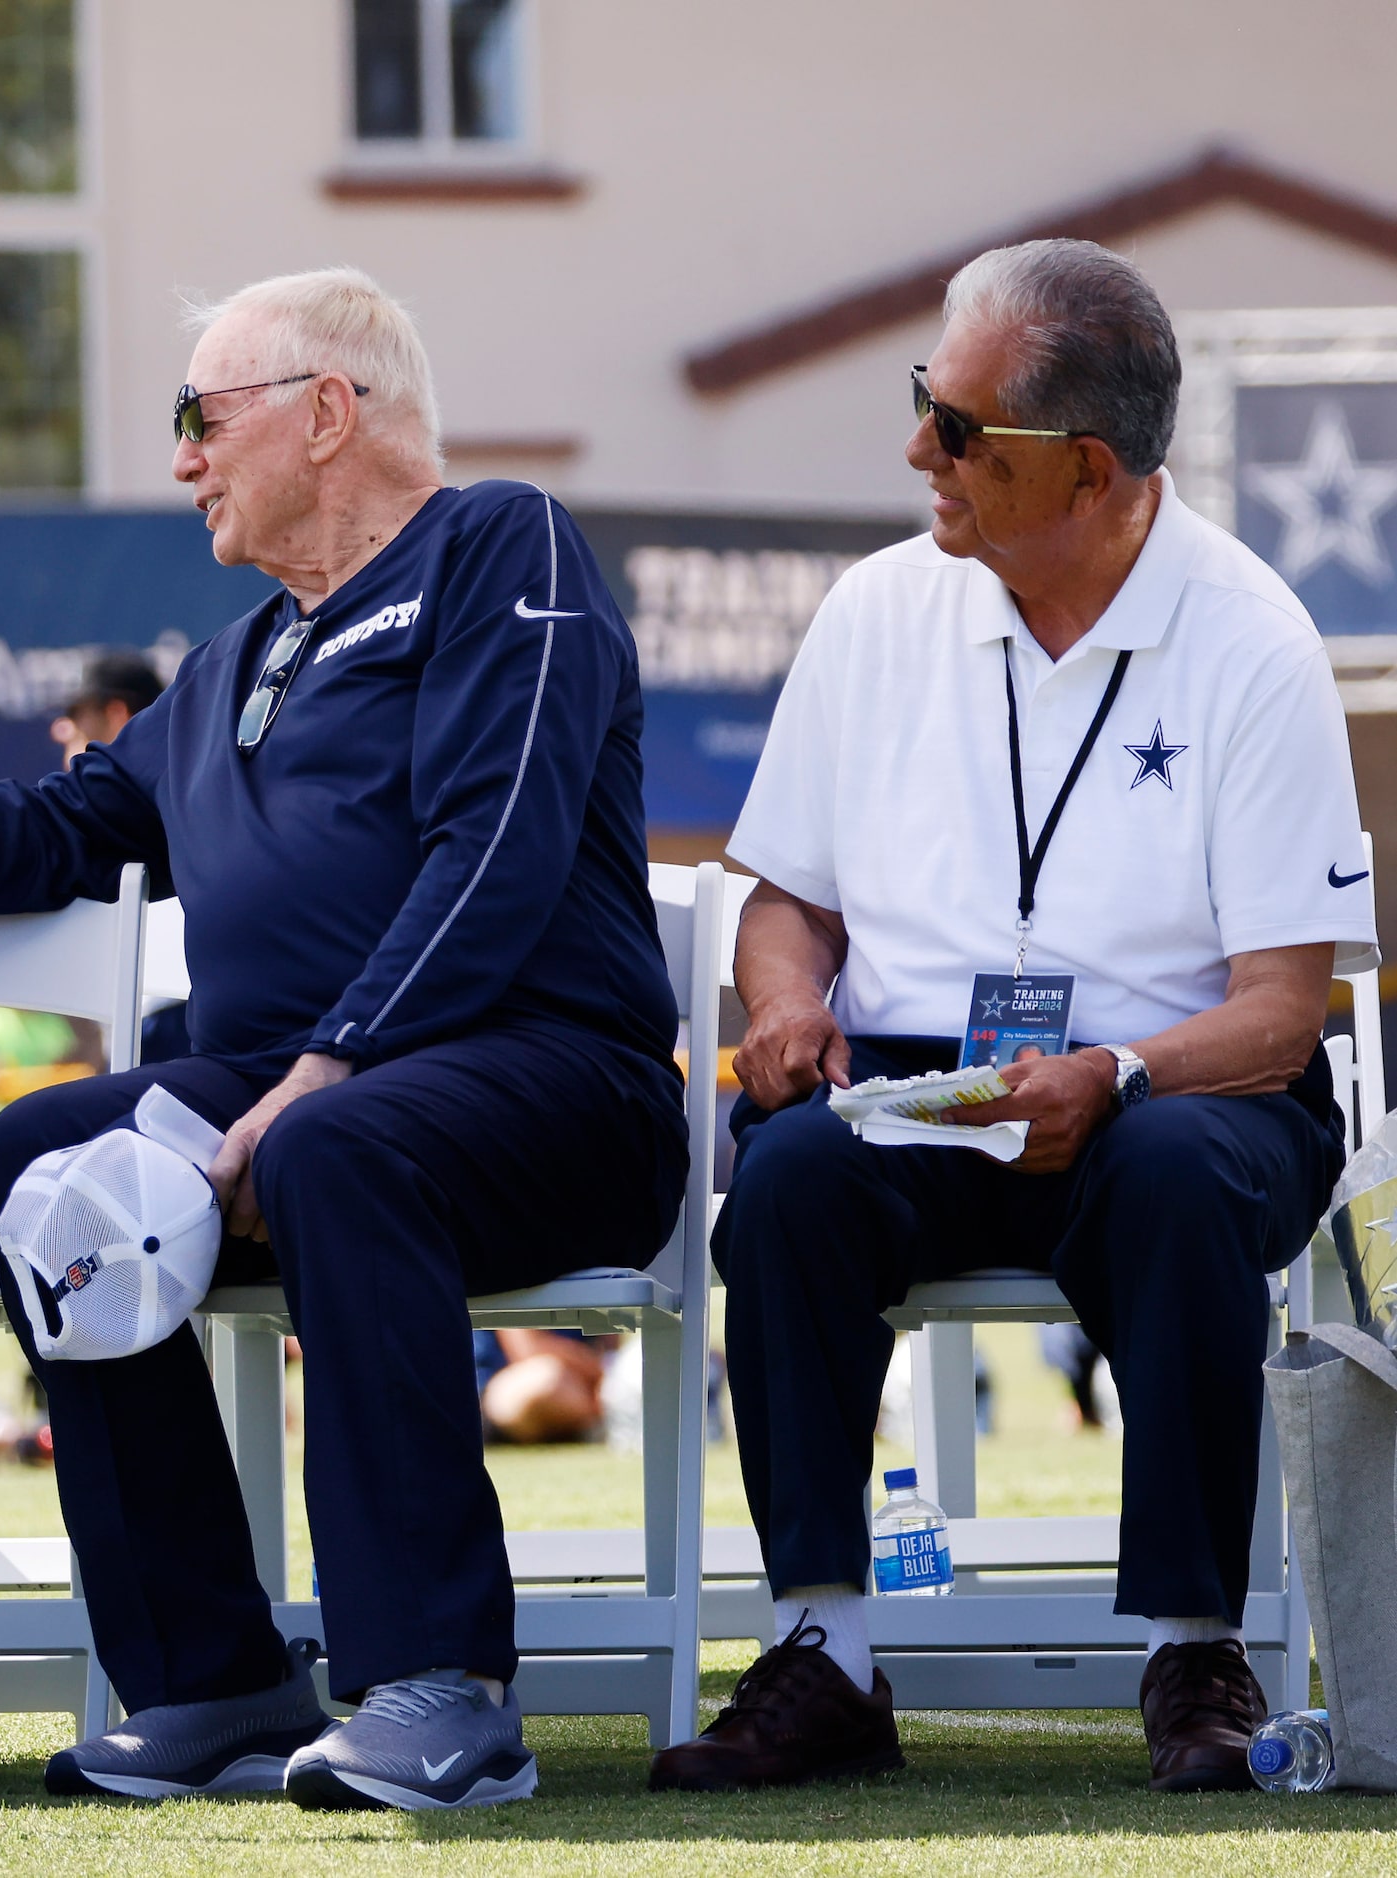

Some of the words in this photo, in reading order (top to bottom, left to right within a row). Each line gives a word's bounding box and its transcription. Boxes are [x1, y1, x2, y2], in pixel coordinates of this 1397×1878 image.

[1013, 989, 1064, 1000] TRAINING
[971, 1029, 997, 1041] 149
[1014, 1031, 1043, 1040] Manager's
[900, 1534, 934, 1557] DEJA
[904, 1554, 937, 1578] BLUE
